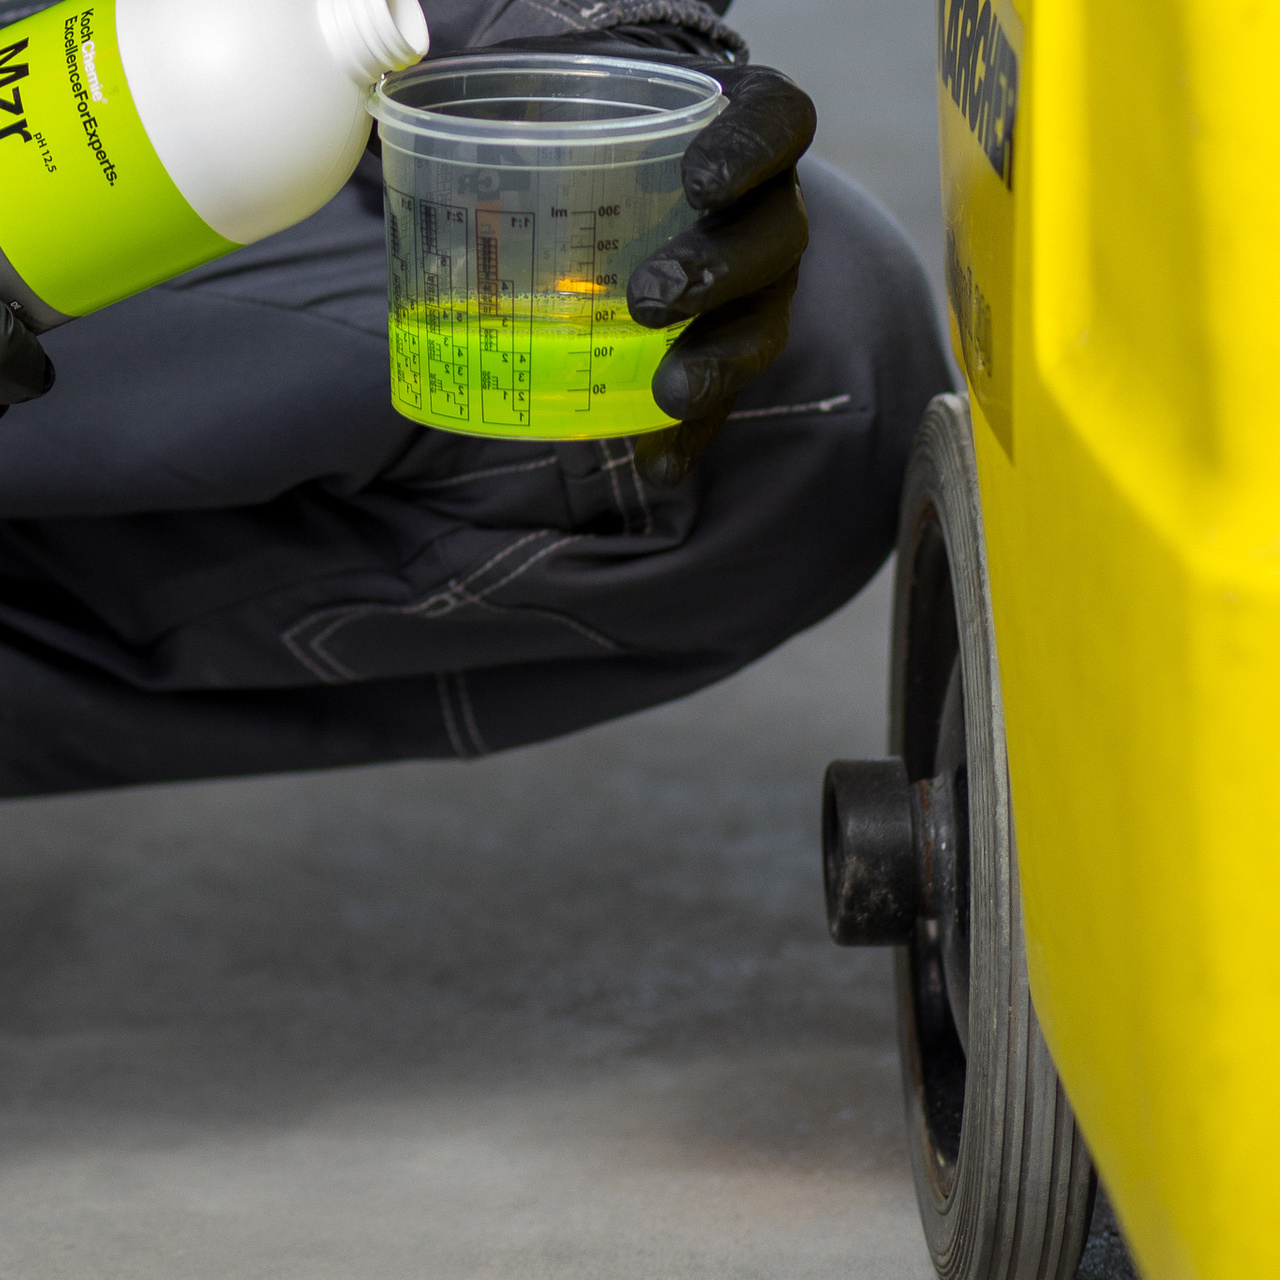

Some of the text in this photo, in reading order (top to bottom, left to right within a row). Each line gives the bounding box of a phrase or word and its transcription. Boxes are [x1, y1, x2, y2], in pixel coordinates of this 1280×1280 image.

[32, 131, 58, 174] pH 12,5
[63, 15, 118, 187] ExcellenceForExperts.
